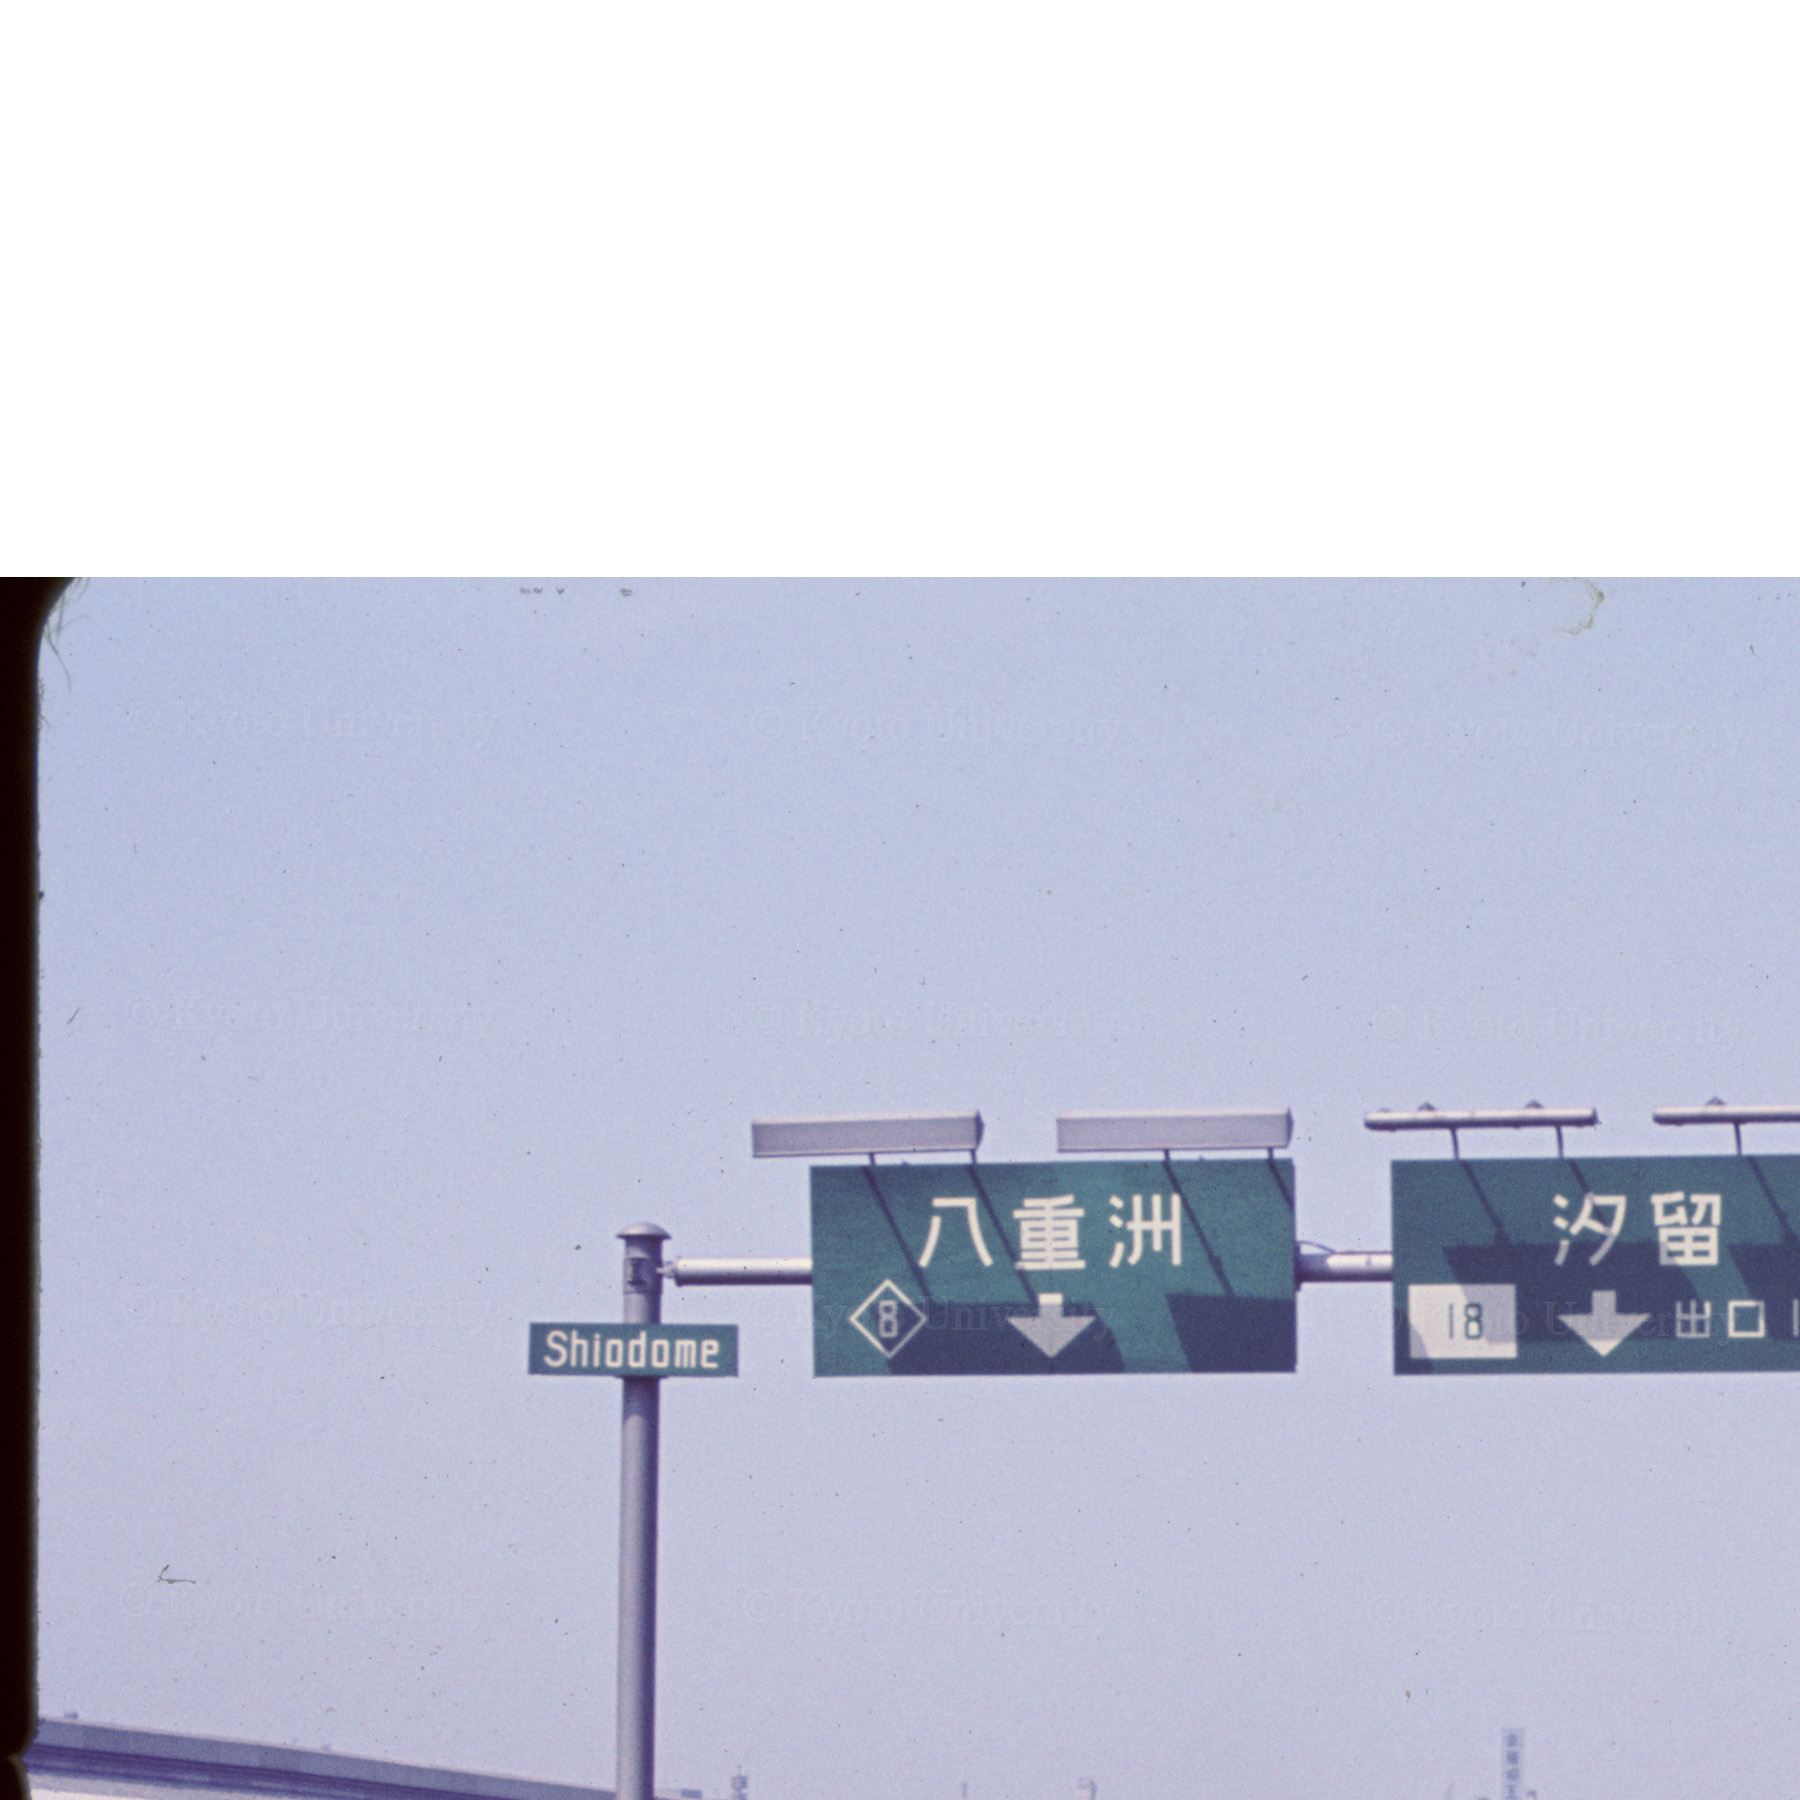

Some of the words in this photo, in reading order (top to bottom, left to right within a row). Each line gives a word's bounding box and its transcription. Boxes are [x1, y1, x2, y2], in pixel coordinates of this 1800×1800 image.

[918, 1194, 1184, 1270] 八重洲
[1553, 1191, 1722, 1266] 汐留
[877, 1299, 899, 1338] 8
[1446, 1302, 1483, 1340] 18
[1675, 1299, 1766, 1339] 出口
[543, 1330, 720, 1369] Shiodome
